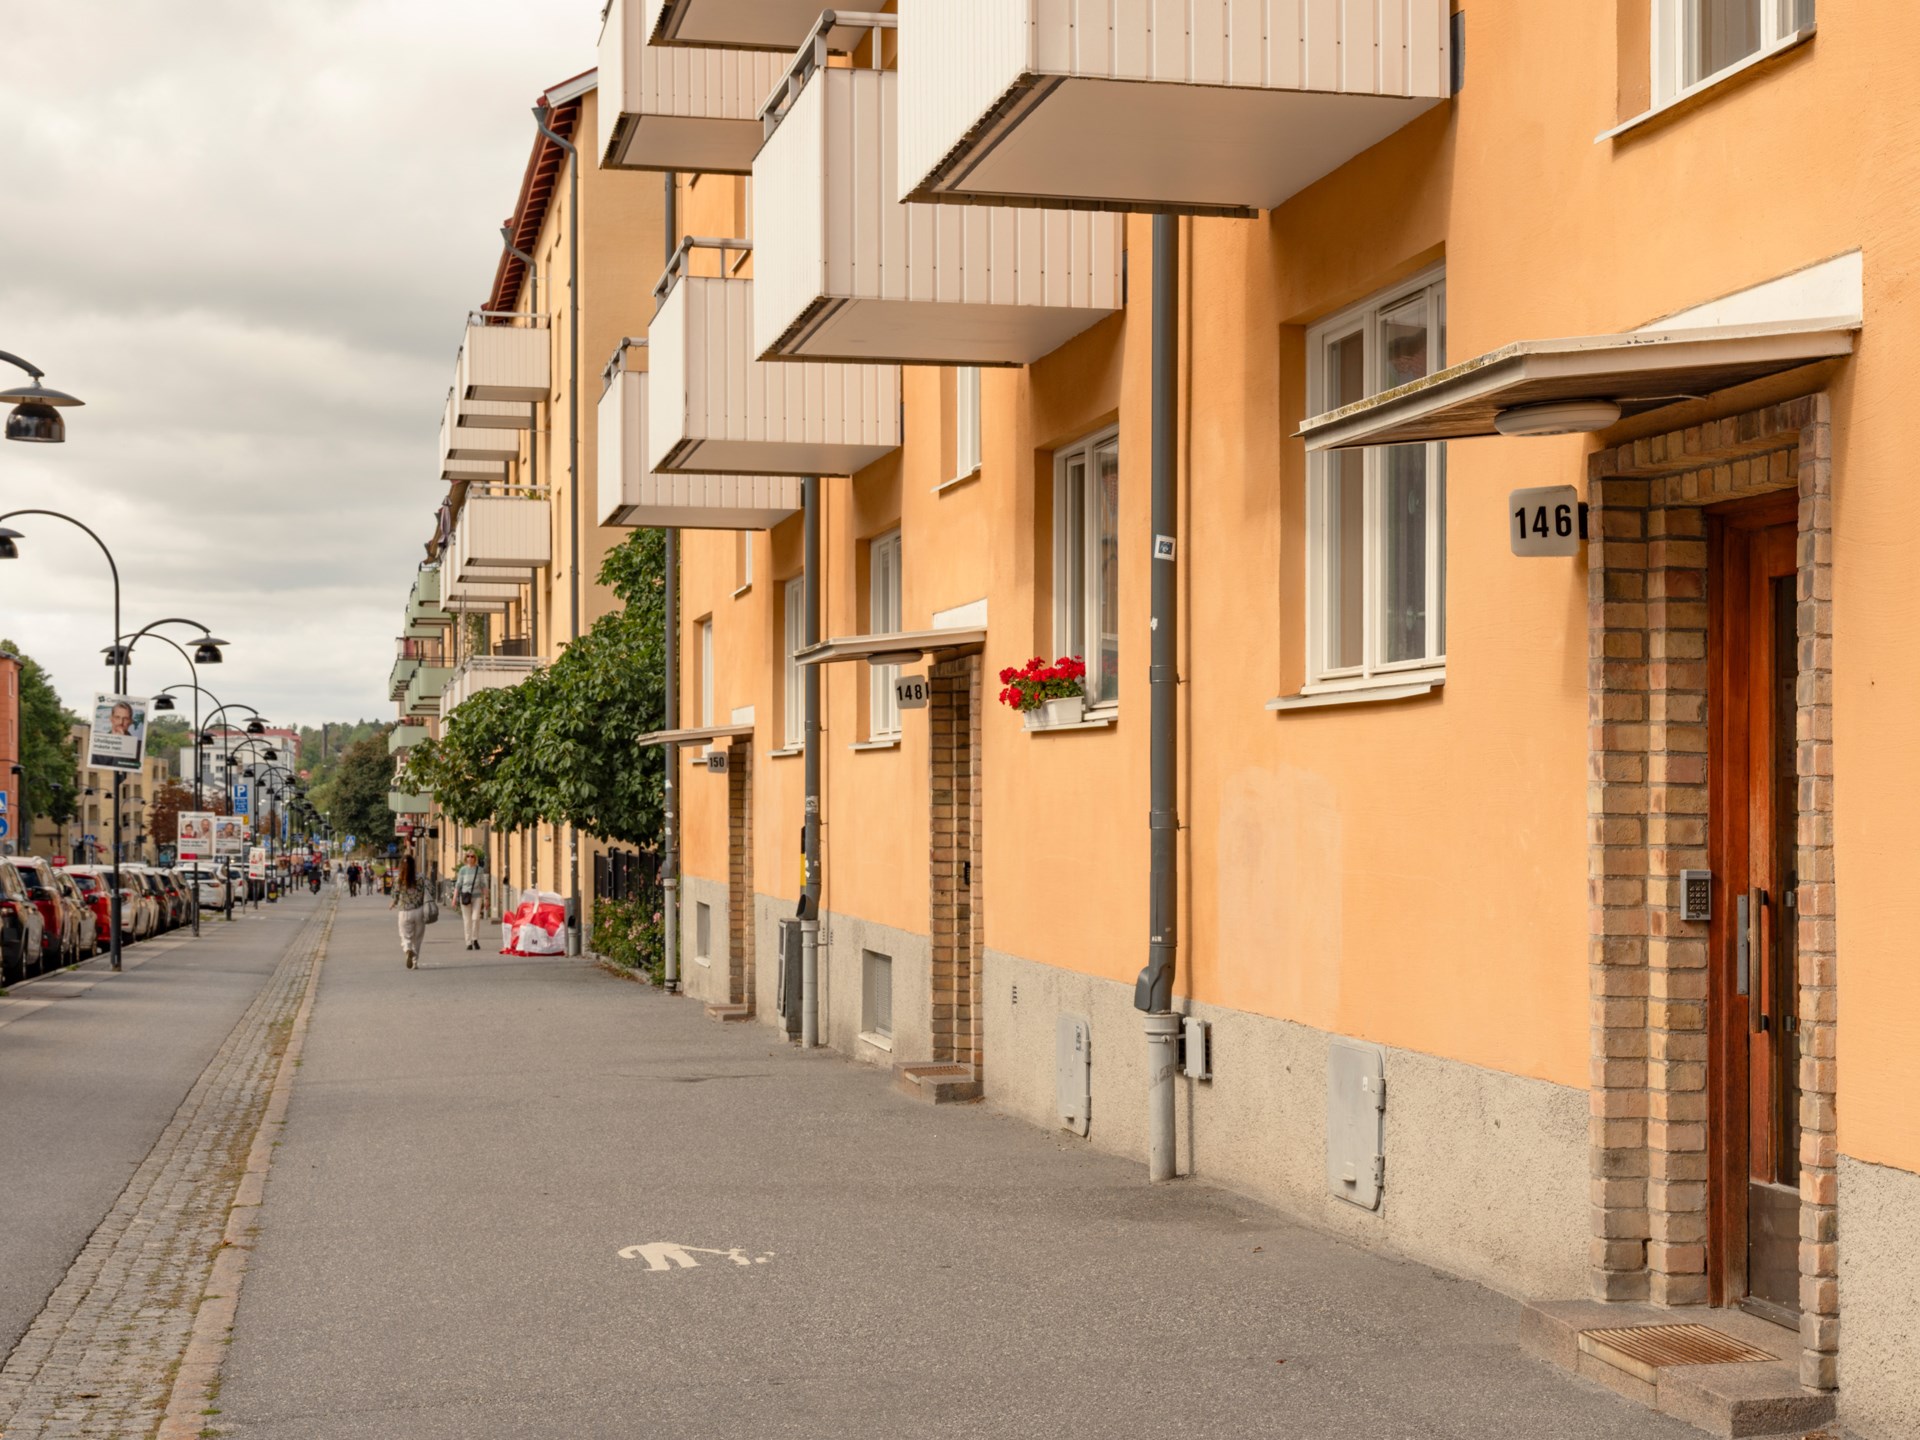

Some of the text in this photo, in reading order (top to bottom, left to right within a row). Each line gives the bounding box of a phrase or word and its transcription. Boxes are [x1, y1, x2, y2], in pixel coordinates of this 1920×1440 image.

[1515, 504, 1572, 539] 146
[896, 684, 923, 701] 148
[709, 756, 725, 768] 150
[237, 786, 246, 797] P
